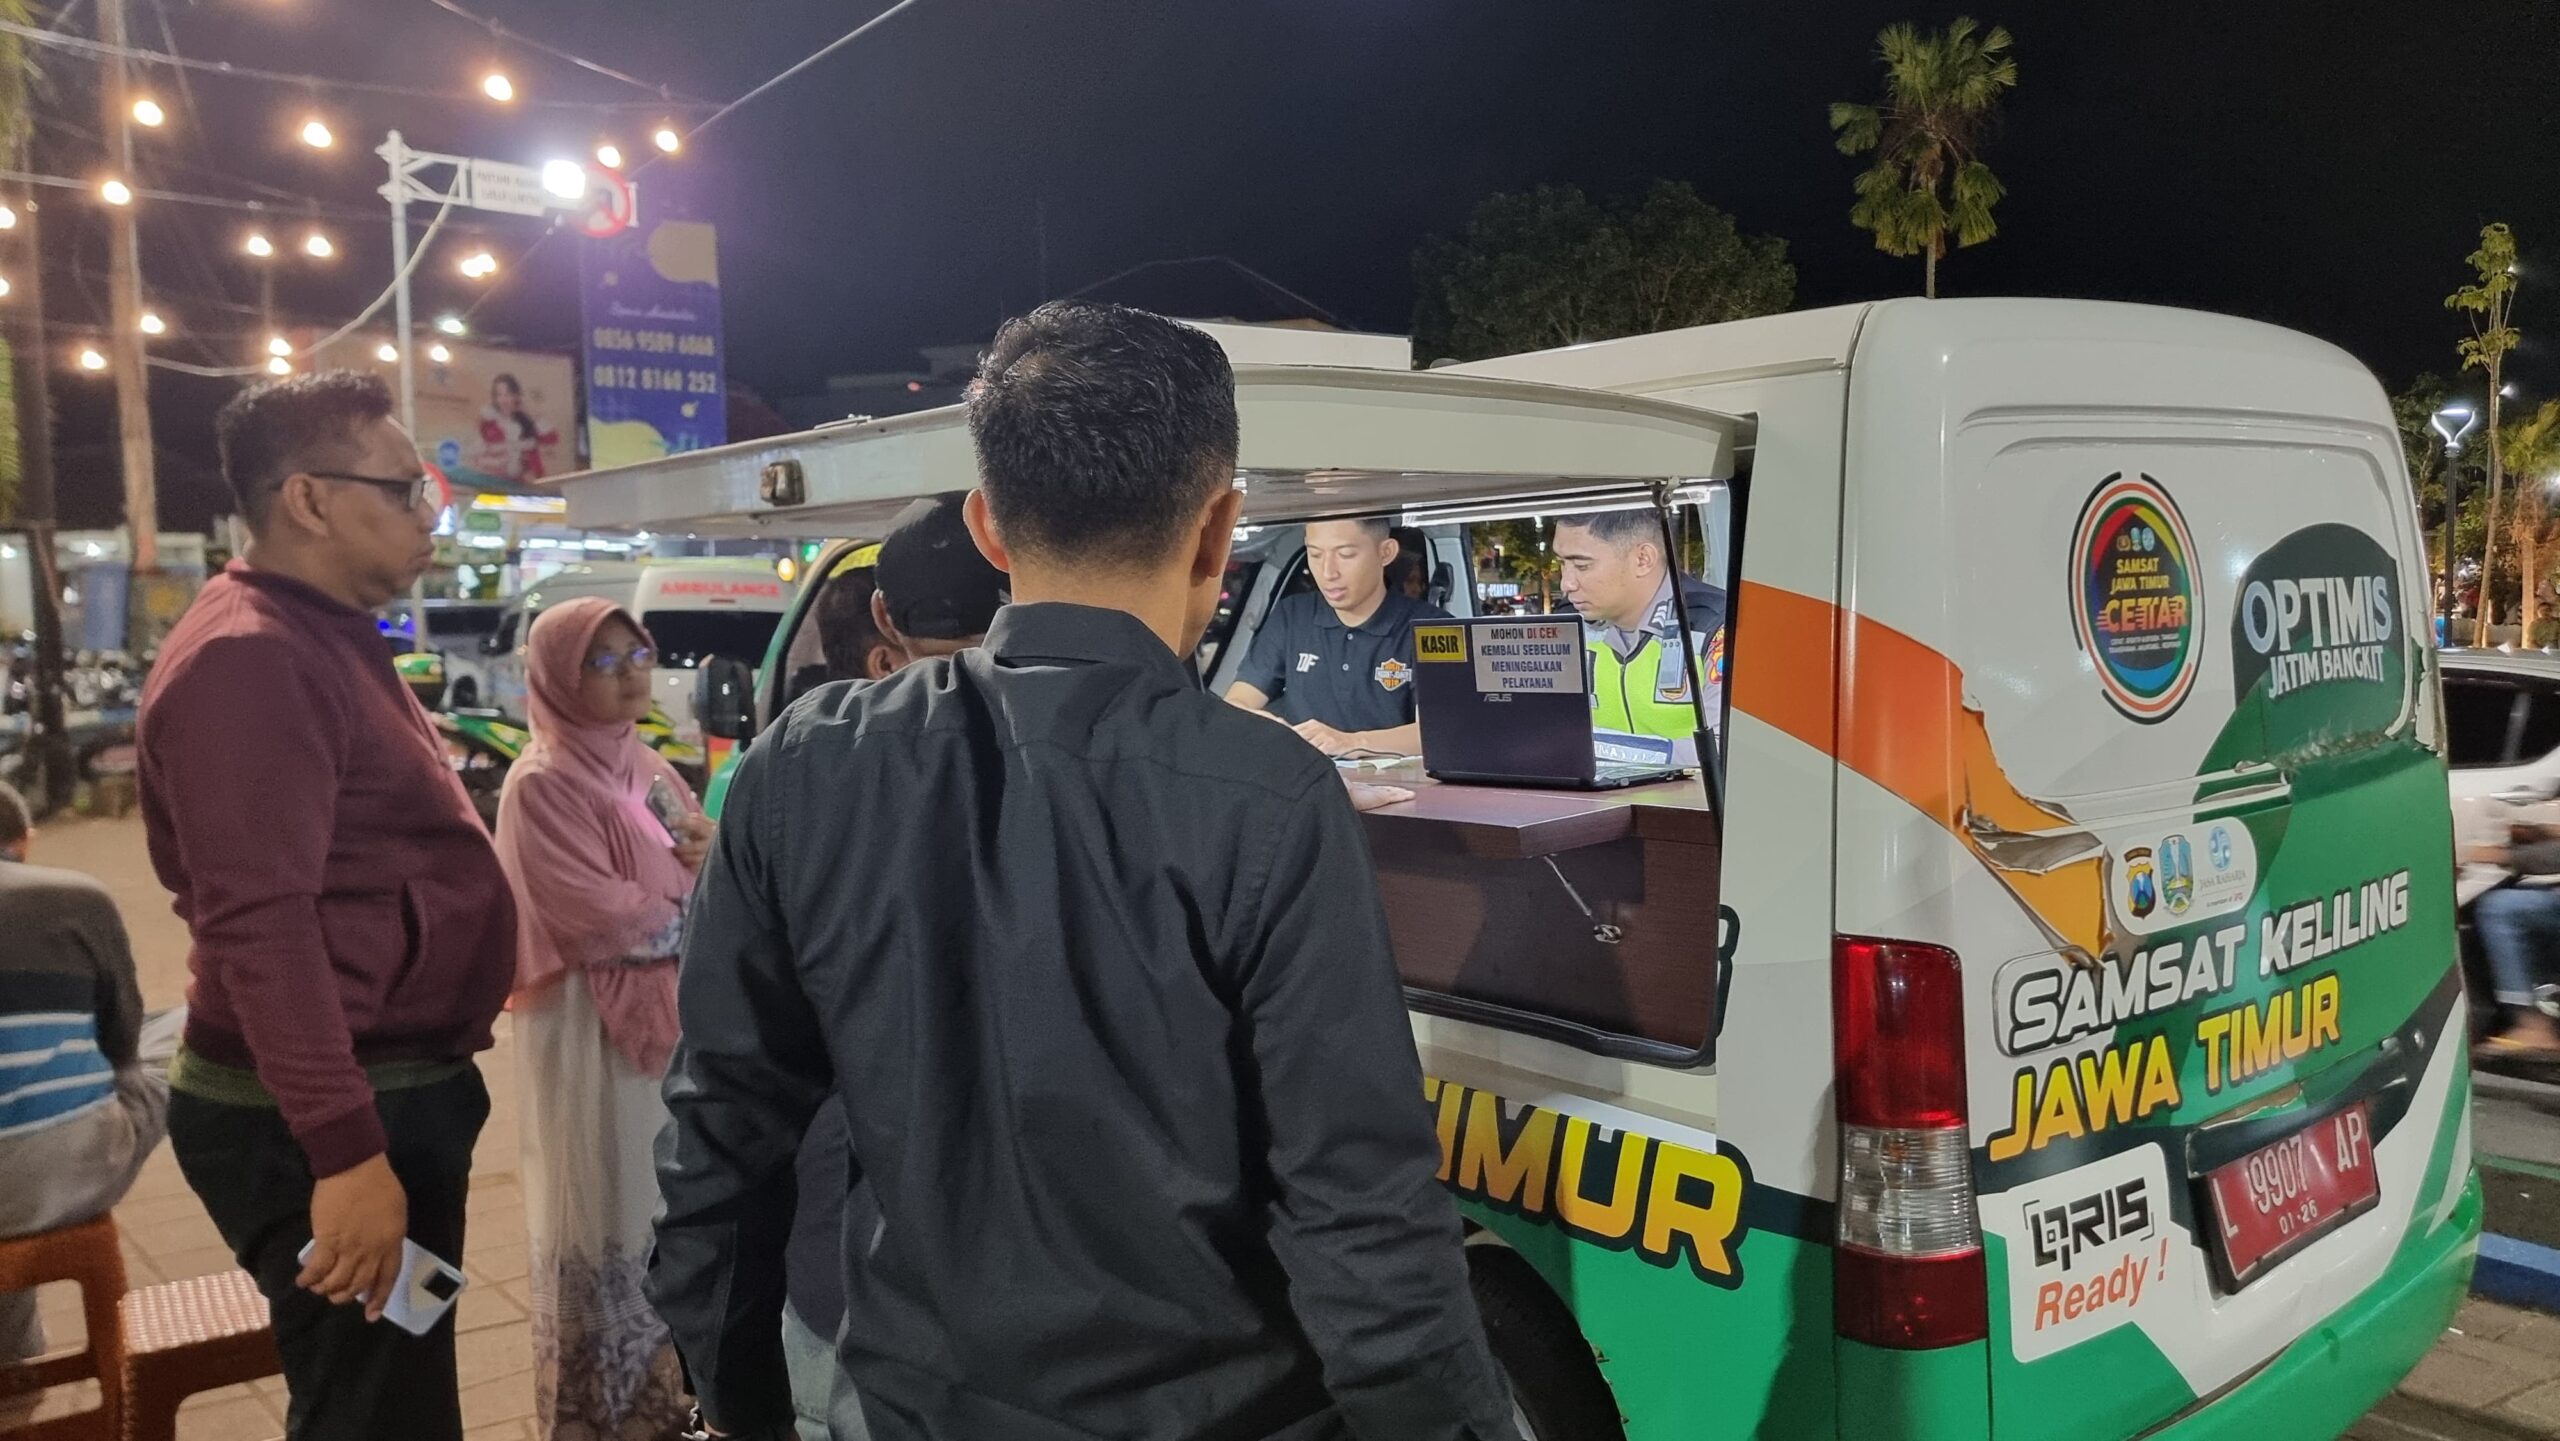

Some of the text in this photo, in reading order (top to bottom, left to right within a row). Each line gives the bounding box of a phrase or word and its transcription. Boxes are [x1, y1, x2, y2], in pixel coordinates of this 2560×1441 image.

[2116, 557, 2159, 574] SAMSAT
[660, 582, 782, 598] AMBULANCE
[2110, 575, 2170, 595] JAWA TIMUR
[2242, 575, 2392, 654] OPTIMIS
[1491, 627, 1558, 640] MOHON DI CEK
[1421, 635, 1459, 653] KASIR
[1481, 643, 1571, 656] KEMBALI SEBELLUM
[1491, 660, 1562, 672] MENINGGALKAN
[2268, 645, 2384, 699] JATIM BANGKIT
[1502, 677, 1553, 689] PELAYANAN
[1483, 693, 1512, 702] ASUS
[2011, 870, 2408, 1051] SAMSAT KELILING
[1988, 974, 2340, 1162] JAWA TIMUR
[1424, 1077, 1742, 1275] IMUR
[2212, 1111, 2363, 1238] L 9907 AP
[2029, 1176, 2151, 1272] QRIS
[2034, 1253, 2150, 1331] Ready
